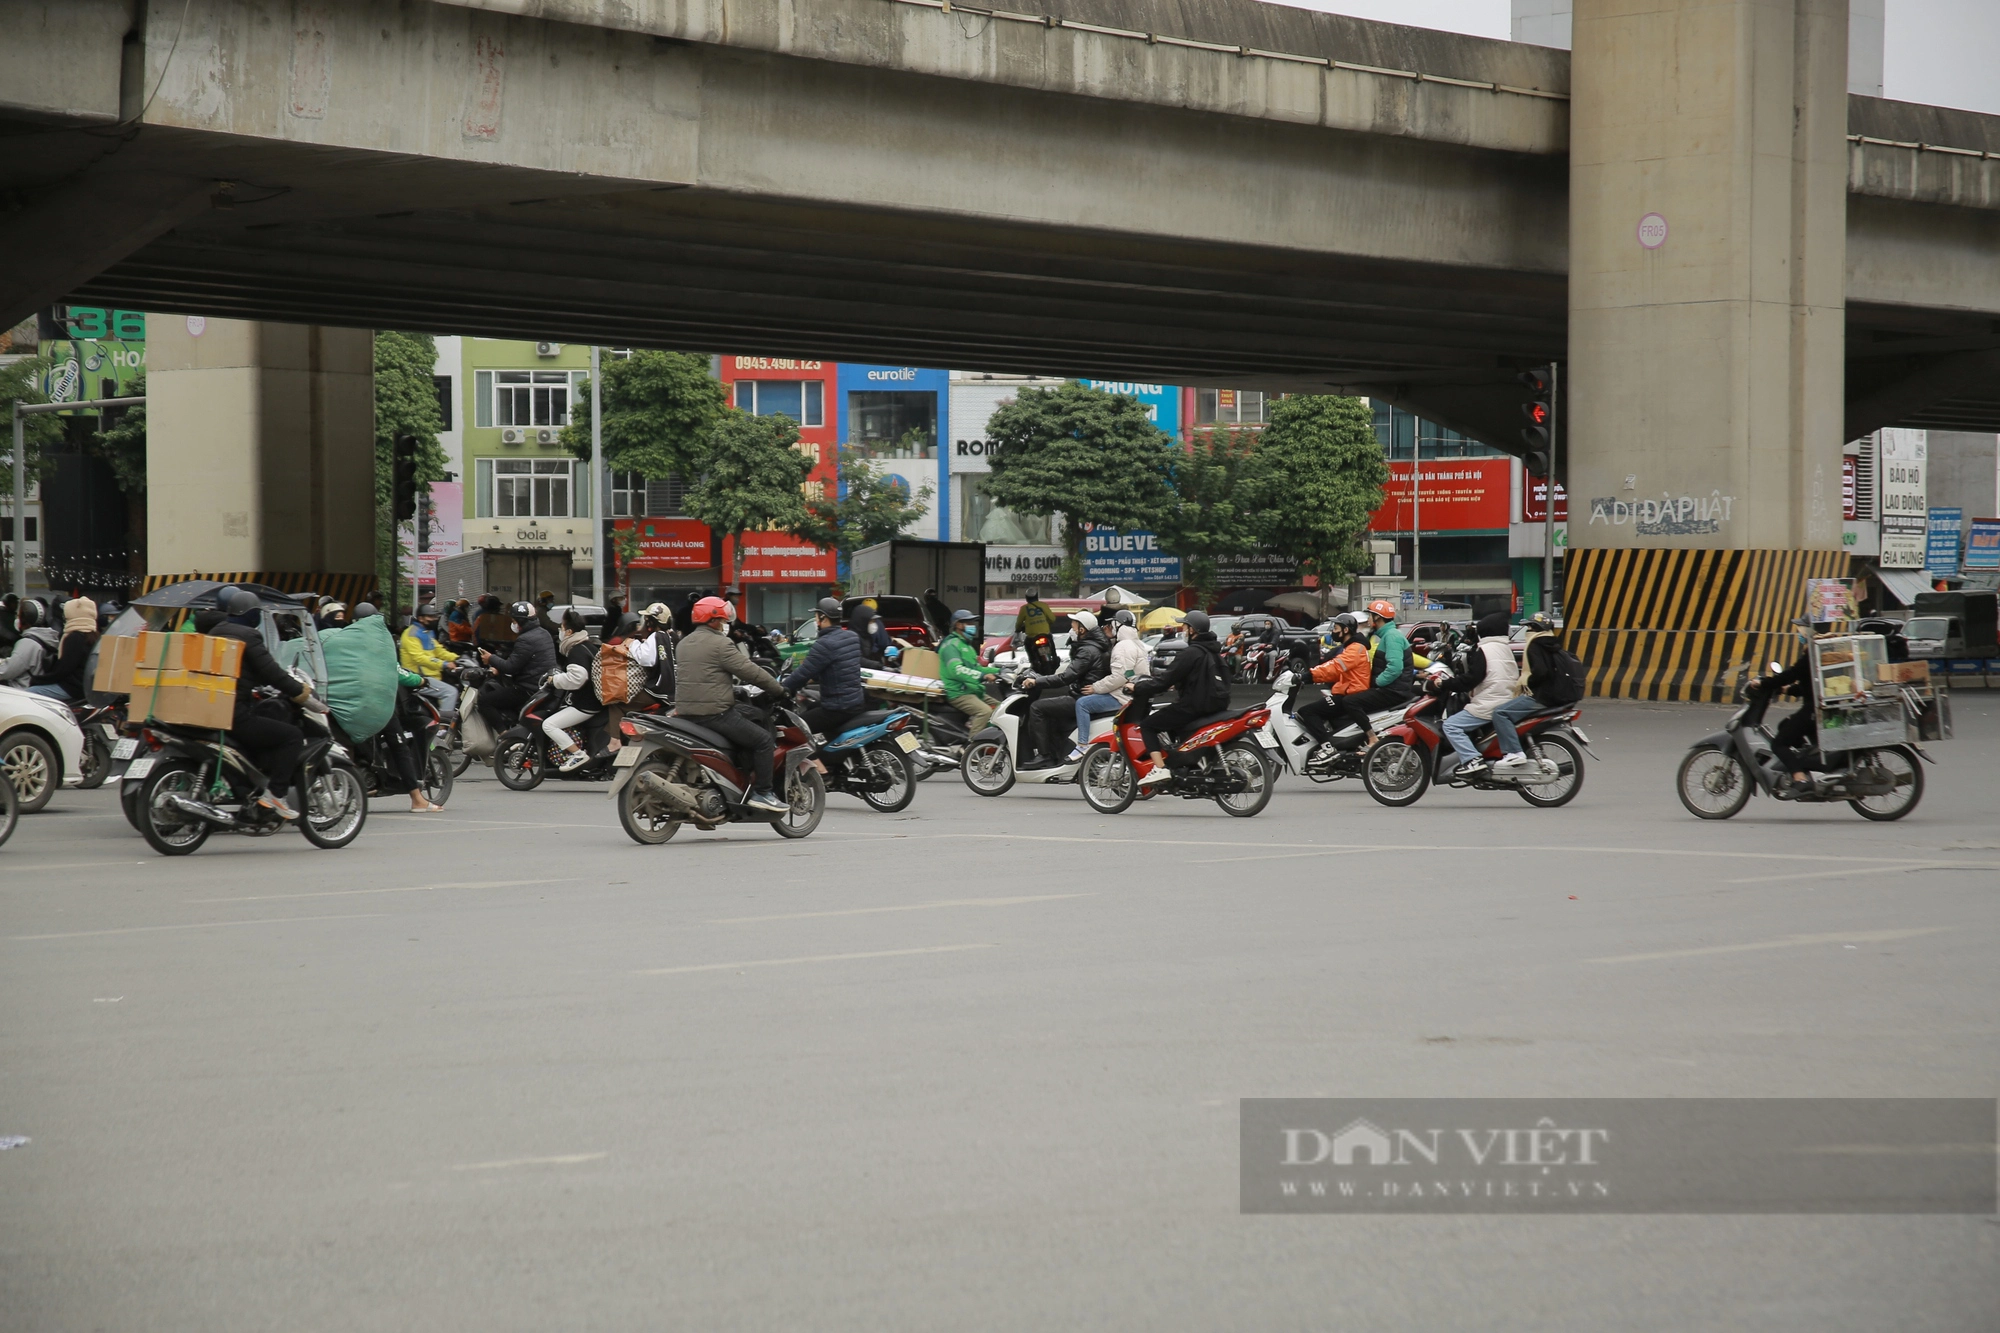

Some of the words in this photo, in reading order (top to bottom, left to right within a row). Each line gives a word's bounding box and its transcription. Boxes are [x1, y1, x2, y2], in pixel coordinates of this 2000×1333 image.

[1641, 225, 1664, 237] FR05
[1889, 463, 1906, 484] BẢO
[1908, 465, 1920, 487] HỘ
[1884, 494, 1900, 510] LAO
[1901, 492, 1925, 514] ĐỘNG
[1588, 503, 1610, 526] A
[650, 540, 670, 548] TOÀN
[671, 540, 684, 548] HẢI
[1014, 554, 1031, 570] ÁO
[1882, 550, 1898, 565] GIA
[1089, 567, 1120, 575] GROOMING
